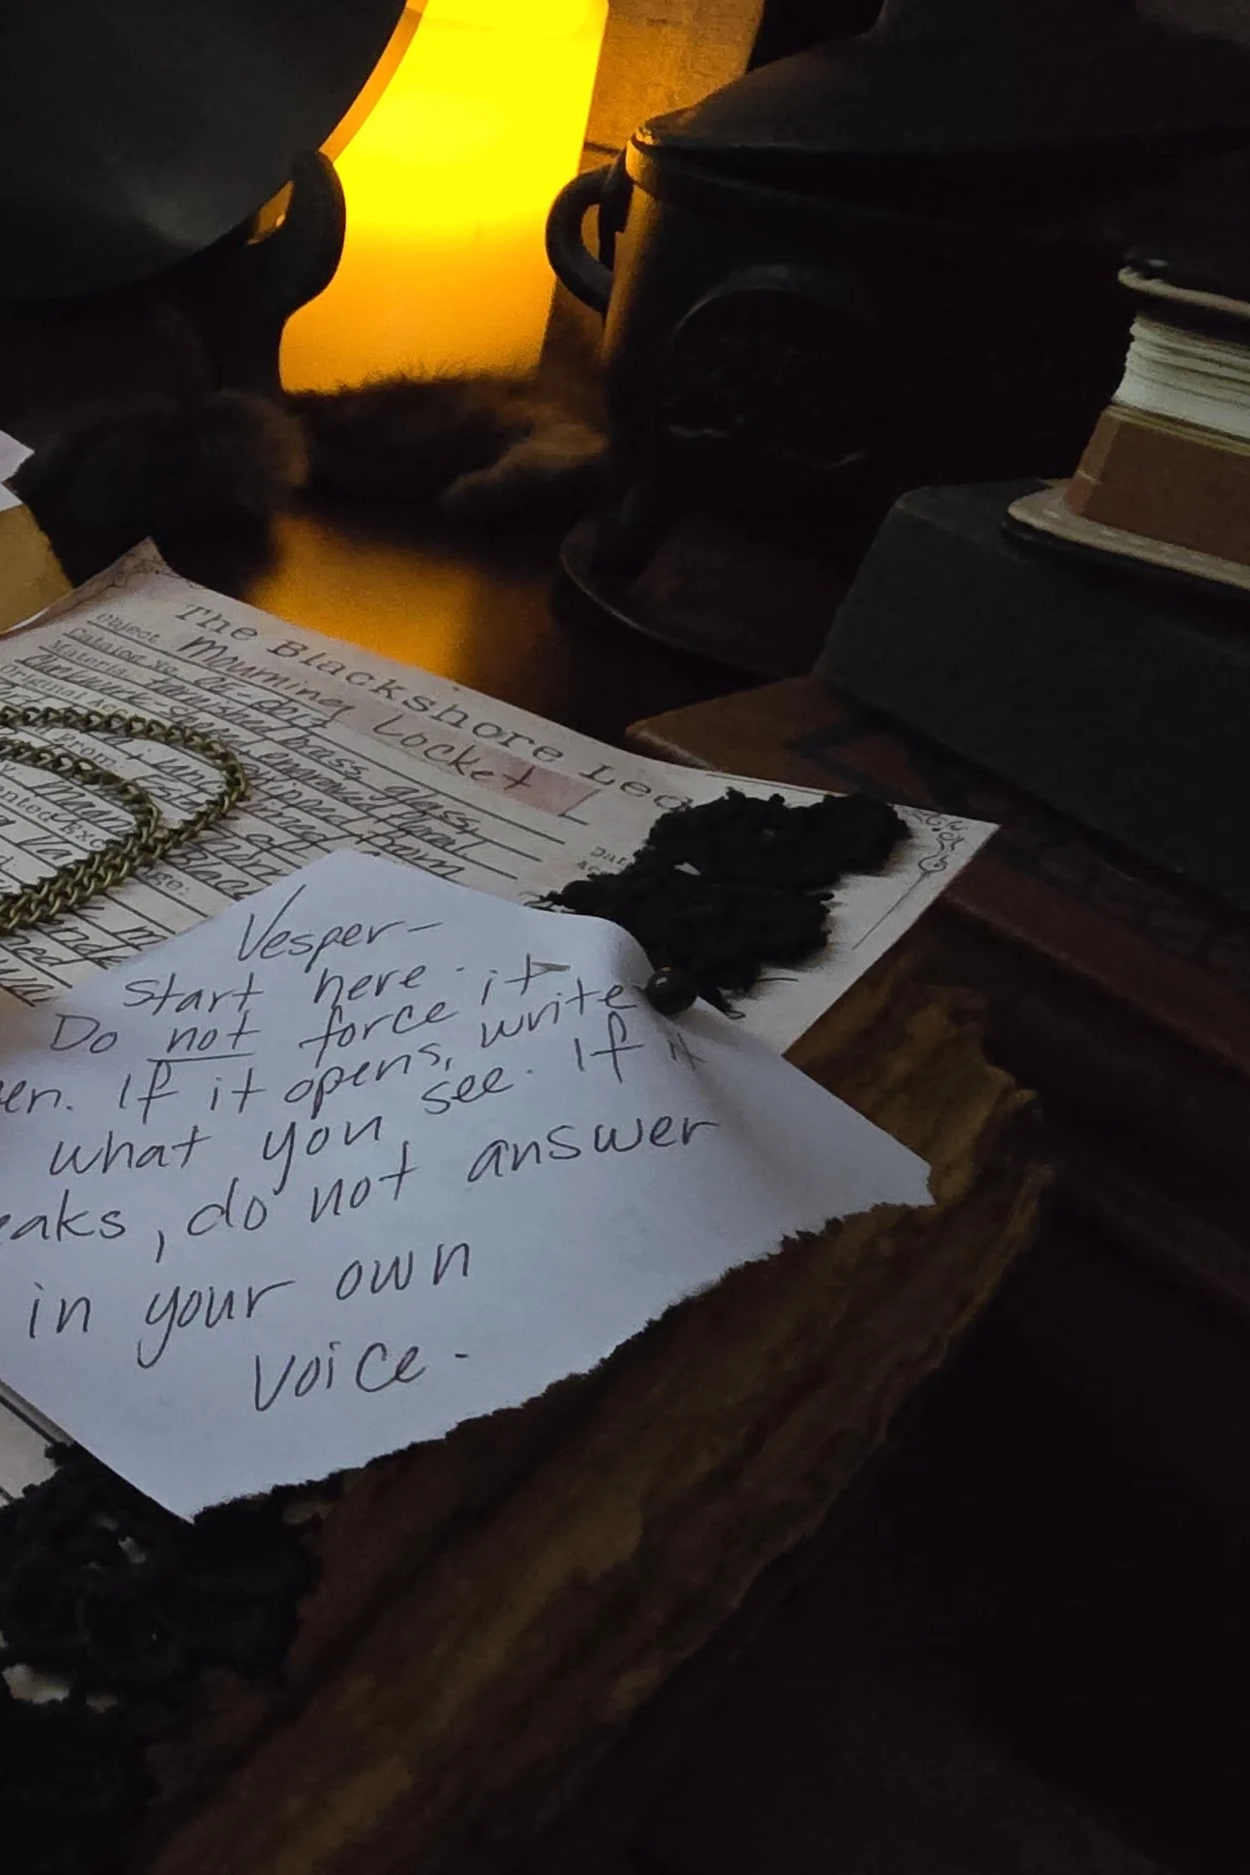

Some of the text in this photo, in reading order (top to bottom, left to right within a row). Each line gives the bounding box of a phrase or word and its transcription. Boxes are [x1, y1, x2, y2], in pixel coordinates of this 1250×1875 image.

[146, 676, 282, 741] tarnished
[175, 603, 564, 764] The Blackshore
[177, 635, 356, 730] Mourning
[371, 713, 537, 791] Locket
[48, 1124, 214, 1177] what
[261, 1115, 384, 1196] you
[573, 1010, 645, 1085] If
[50, 1011, 119, 1055] Do
[165, 1009, 262, 1060] not
[297, 999, 459, 1068] force
[120, 1056, 179, 1126] If
[210, 1068, 267, 1114] it
[480, 977, 640, 1049] write
[187, 1177, 268, 1239] do
[310, 1150, 420, 1226] not
[467, 1113, 722, 1184] answer
[27, 1241, 471, 1371] in your own
